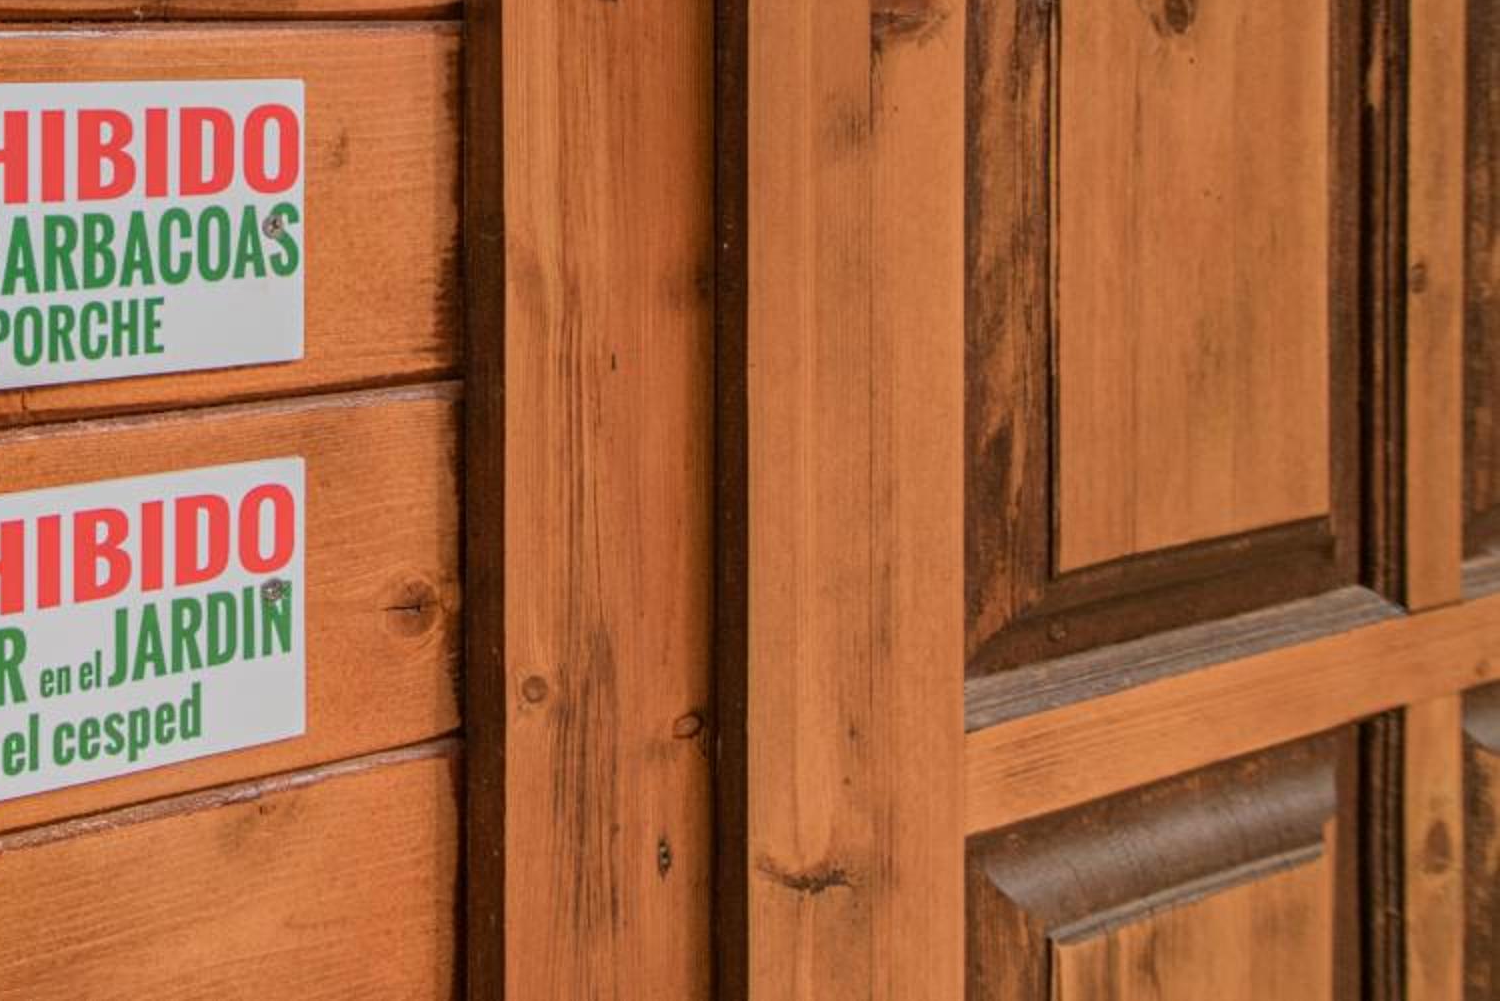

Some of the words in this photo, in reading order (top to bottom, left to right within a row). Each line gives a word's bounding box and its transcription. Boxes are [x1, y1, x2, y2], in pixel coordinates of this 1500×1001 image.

[39, 662, 71, 699] en
[79, 650, 102, 690] el
[107, 580, 293, 688] JARDIN
[3, 713, 39, 777] el
[52, 682, 202, 765] cesped
